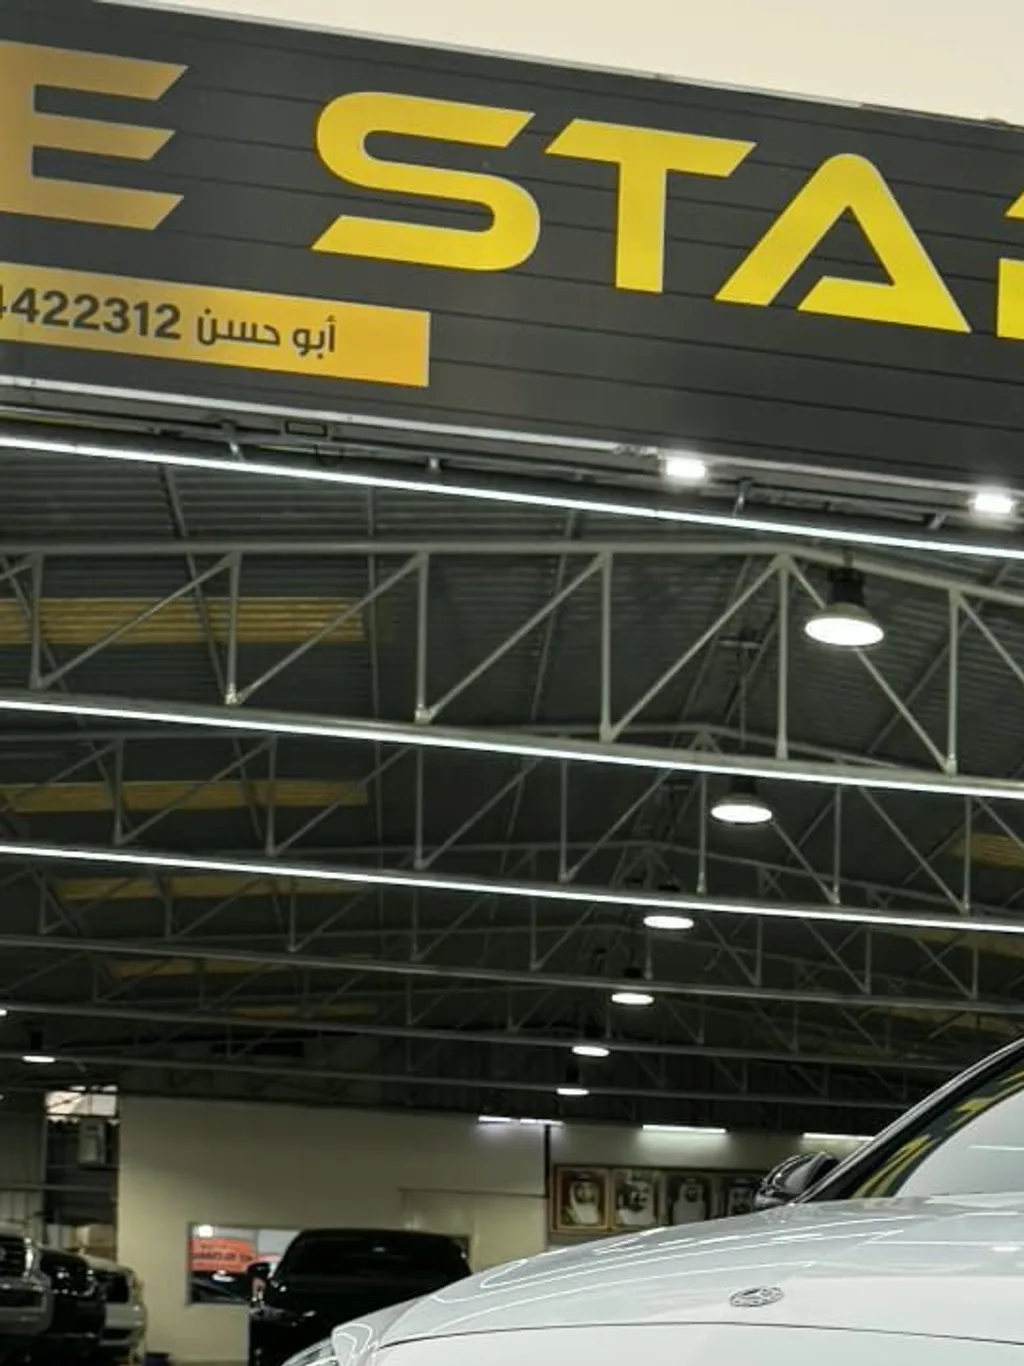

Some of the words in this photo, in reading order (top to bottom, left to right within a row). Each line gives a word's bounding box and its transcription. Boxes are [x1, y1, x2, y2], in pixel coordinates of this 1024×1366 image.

[0, 40, 189, 230] E
[0, 286, 181, 340] 422312
[196, 308, 281, 346] حسن
[292, 315, 337, 360] أبو
